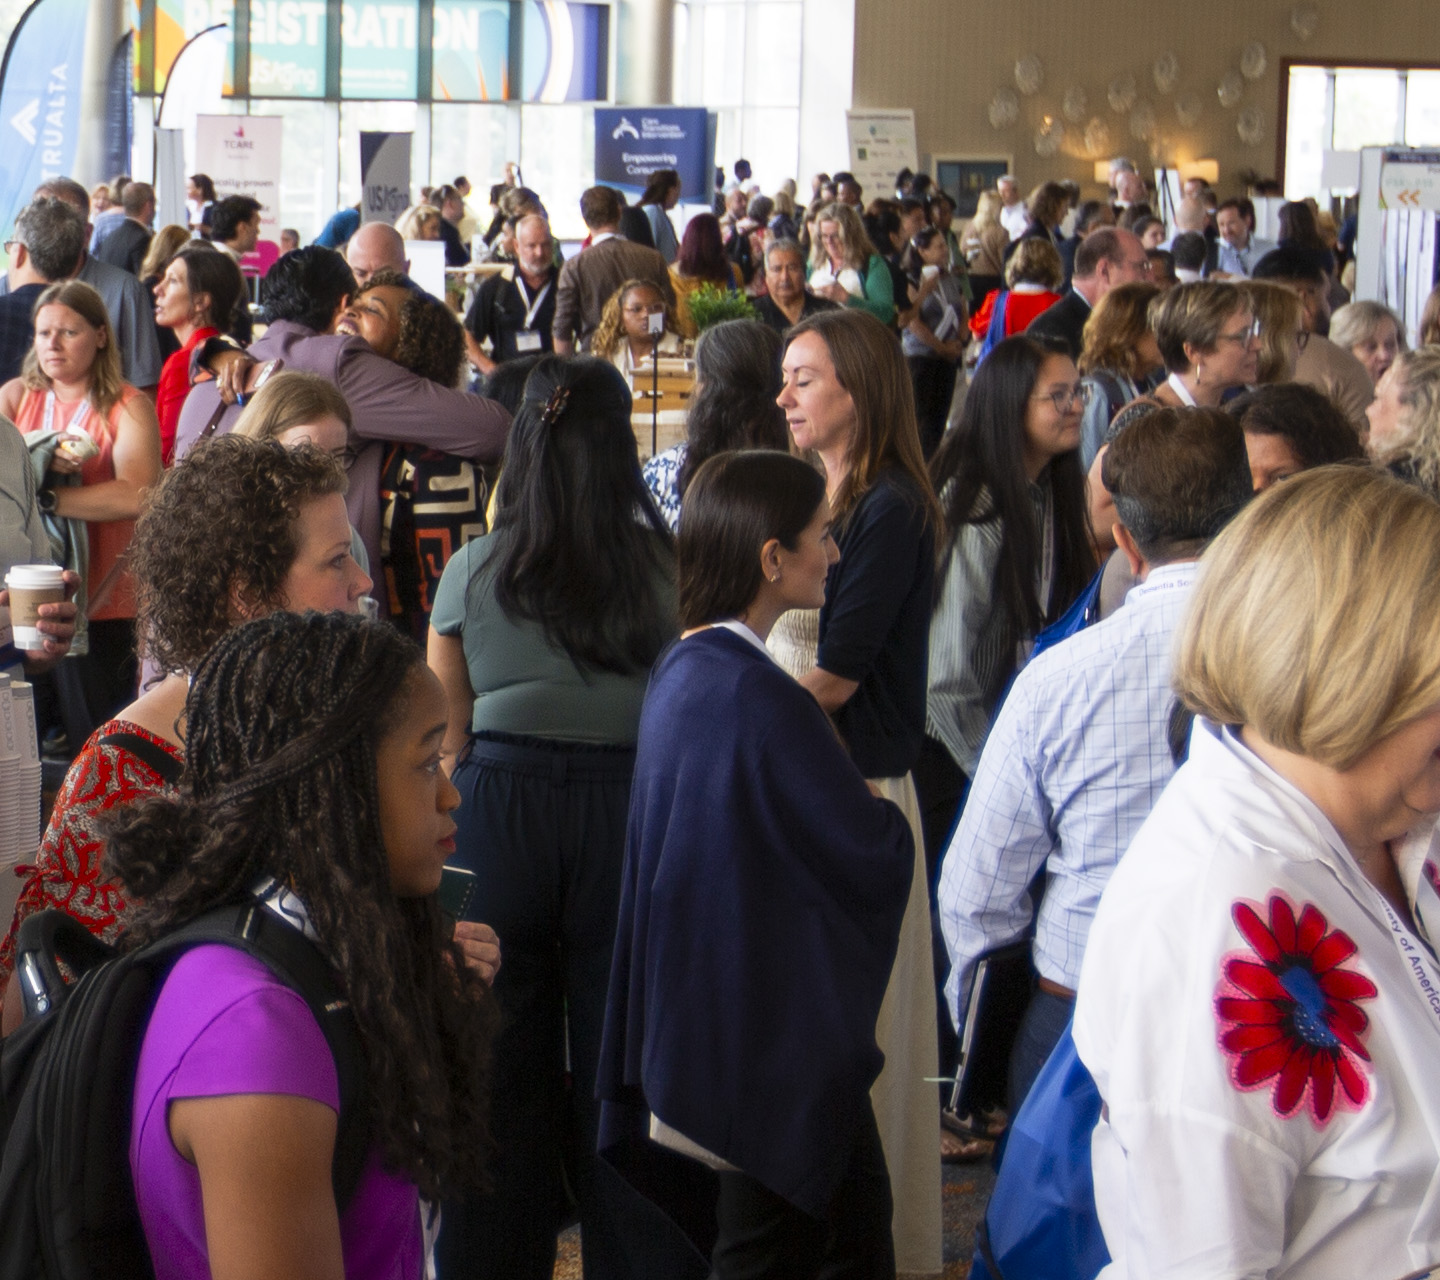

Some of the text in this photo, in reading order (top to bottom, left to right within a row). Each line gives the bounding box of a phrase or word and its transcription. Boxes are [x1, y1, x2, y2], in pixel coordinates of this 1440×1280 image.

[41, 62, 69, 182] TRUALTA
[224, 140, 254, 150] TCARE
[622, 152, 677, 165] Empowering
[1139, 580, 1175, 596] Dementia
[1399, 937, 1415, 955] of
